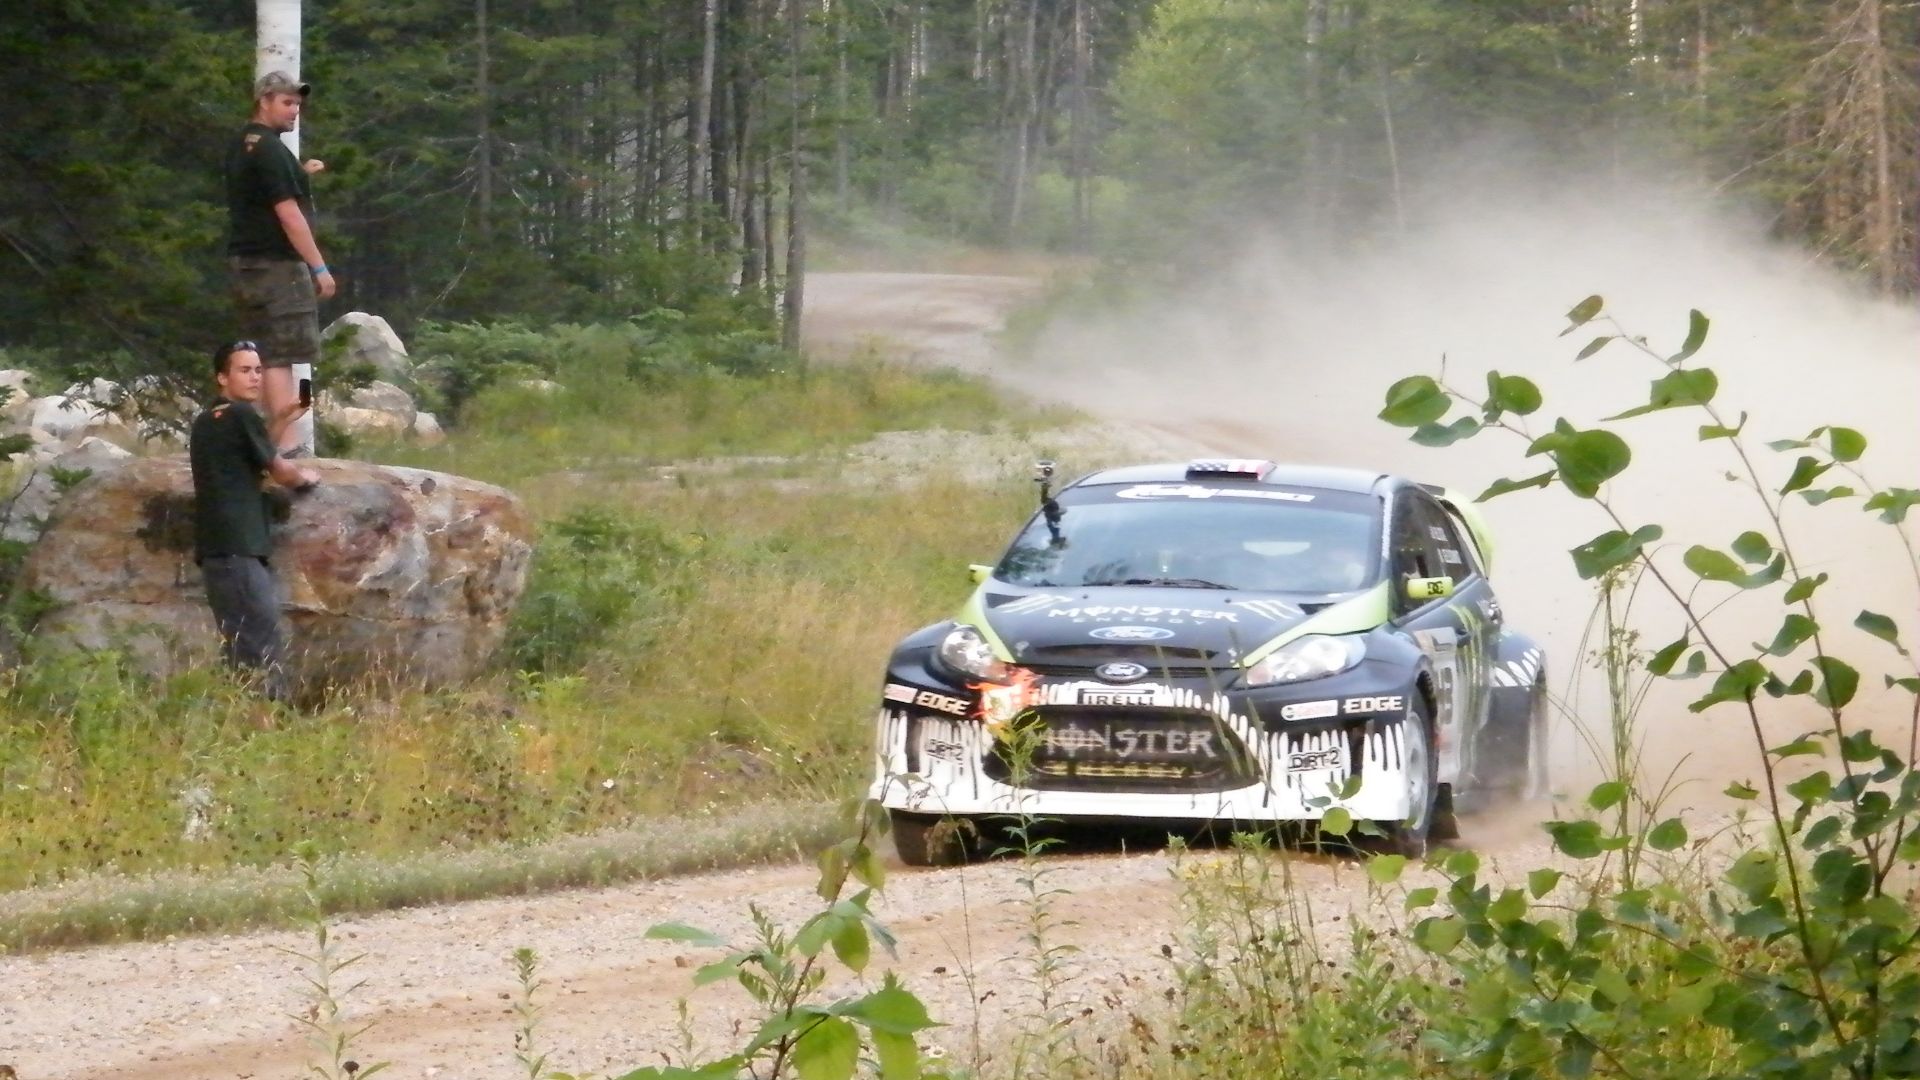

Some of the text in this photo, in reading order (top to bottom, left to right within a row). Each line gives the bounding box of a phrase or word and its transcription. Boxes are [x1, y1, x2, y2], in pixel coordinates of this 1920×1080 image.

[1047, 604, 1240, 623] MONSTER
[915, 690, 972, 716] EDGE
[1344, 696, 1403, 714] EDGE
